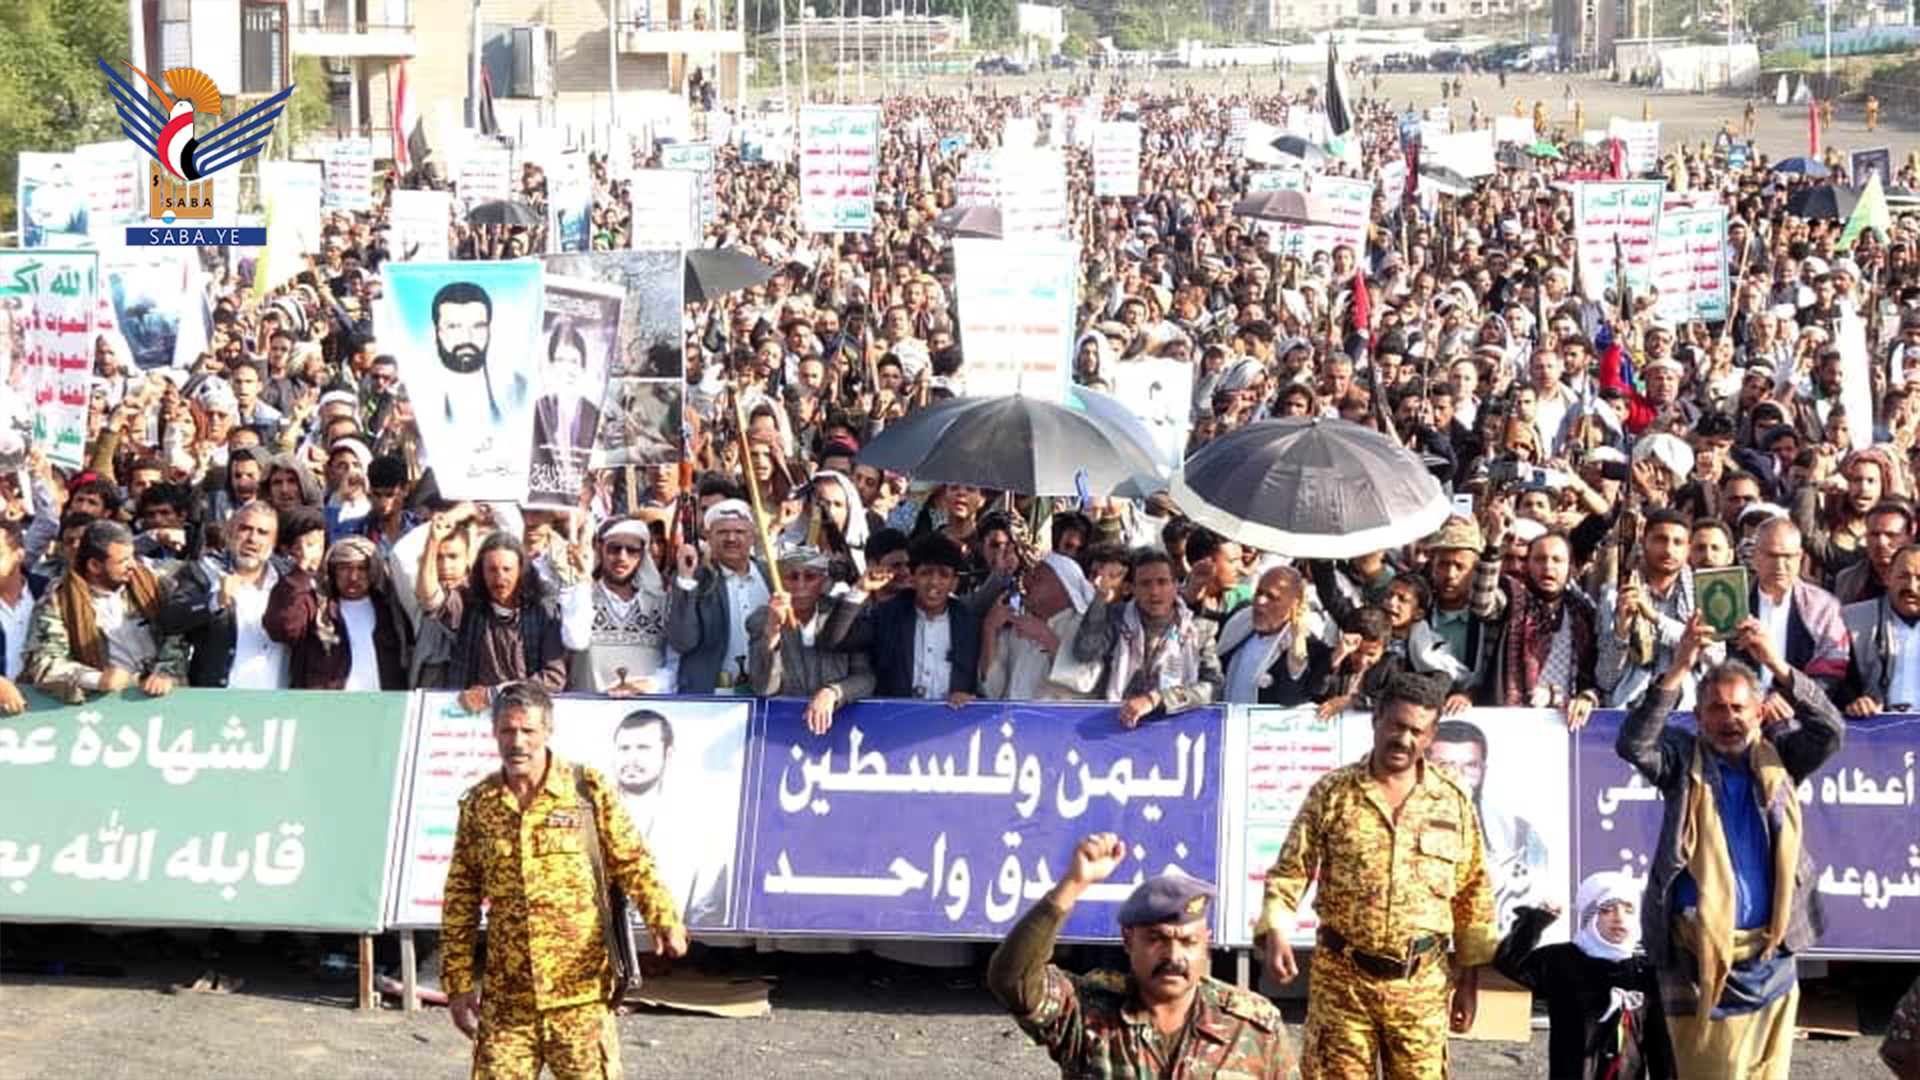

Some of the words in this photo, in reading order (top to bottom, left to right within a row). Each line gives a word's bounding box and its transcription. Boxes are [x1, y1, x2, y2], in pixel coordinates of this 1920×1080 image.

[51, 265, 94, 297] الله
[70, 710, 297, 785] الشهادة
[778, 720, 1042, 819] وفلسطين
[1056, 731, 1207, 821] اليمن
[1821, 751, 1915, 806] أعطاه
[51, 808, 157, 882] الله
[164, 821, 305, 901] قابله
[763, 831, 971, 921] واحد
